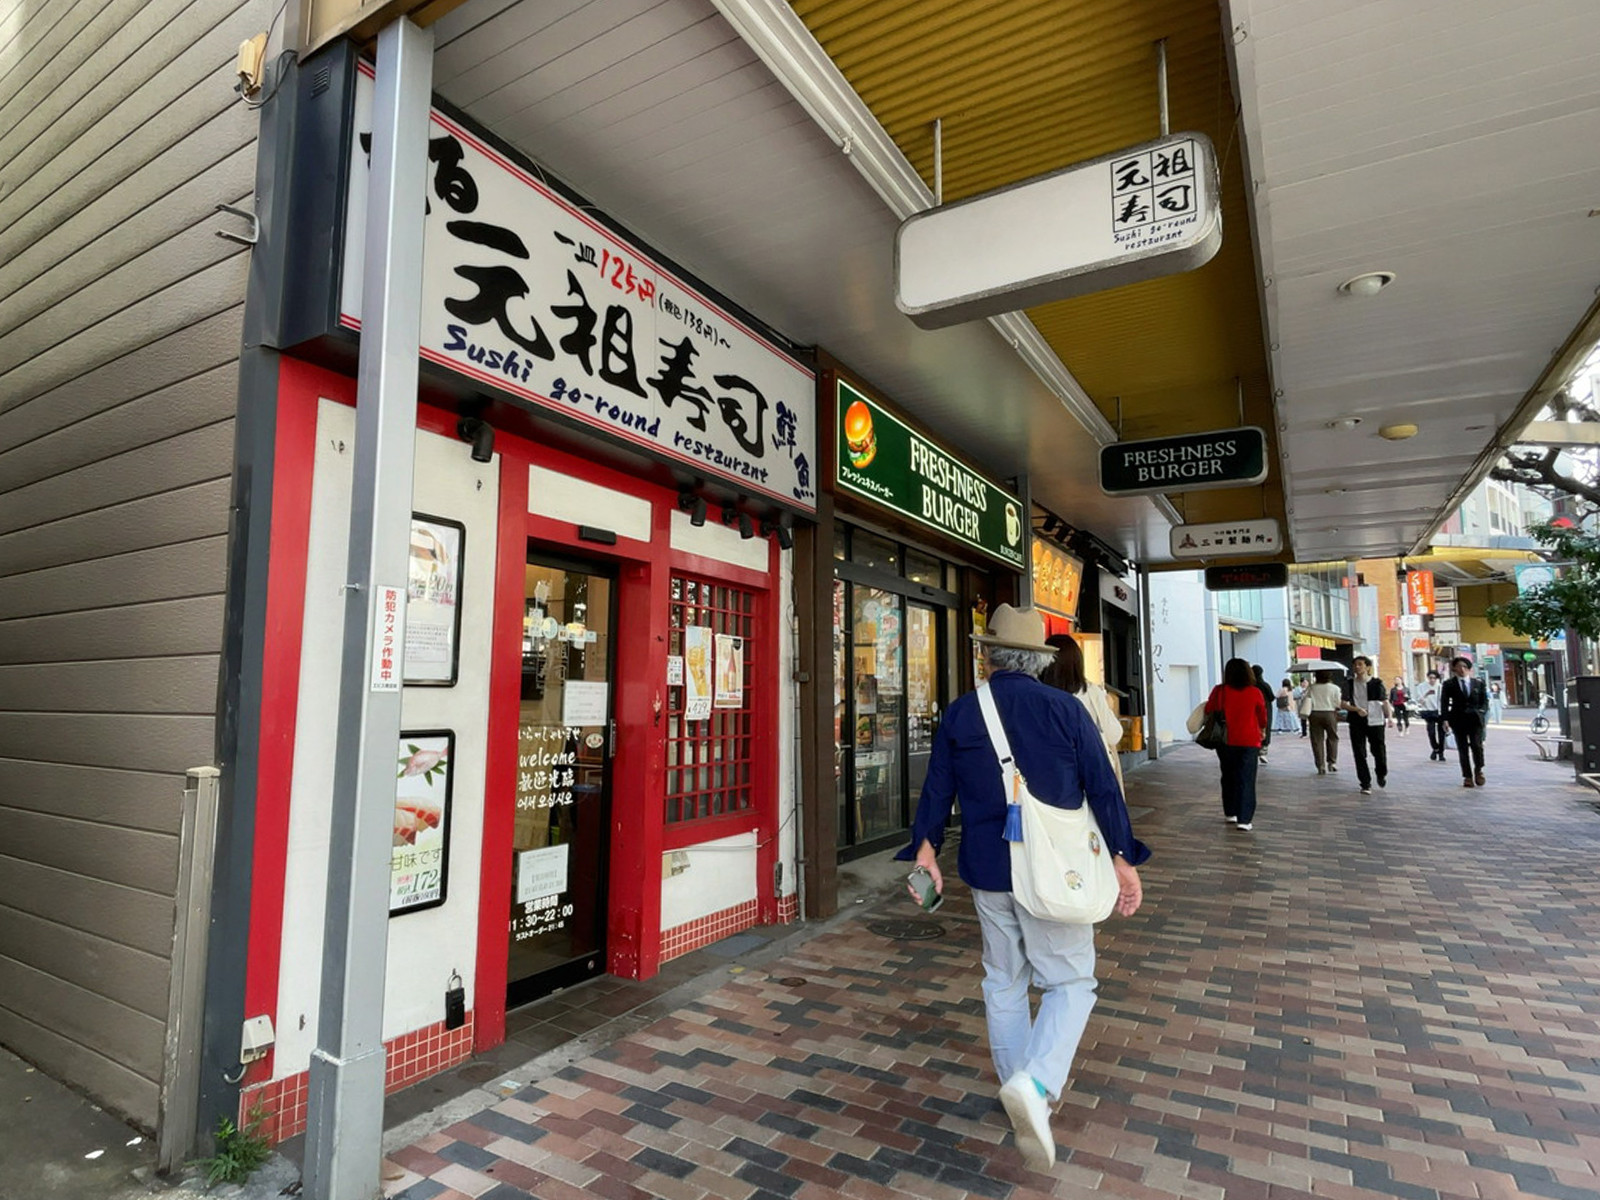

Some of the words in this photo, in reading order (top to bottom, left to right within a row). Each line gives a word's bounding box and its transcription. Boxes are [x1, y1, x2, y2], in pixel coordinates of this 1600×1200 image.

[1115, 147, 1193, 191] 元祖
[1115, 184, 1191, 223] 寿司
[1114, 228, 1142, 244] Sushi
[1150, 213, 1198, 235] go-round
[1124, 229, 1183, 250] restaurant
[444, 220, 769, 457] 元祖寿司
[443, 324, 533, 383] Sushi
[550, 377, 660, 437] go-round
[674, 430, 769, 483] restaurant
[1124, 440, 1237, 467] FRESHNESS
[1138, 459, 1223, 482] BURGER
[910, 436, 987, 513] FRESHNESS
[922, 484, 981, 542] BURGER
[380, 589, 397, 681] 防犯カメラ作動中
[519, 747, 576, 768] welcome
[517, 794, 536, 811] 어서
[537, 791, 574, 809] 오십시오
